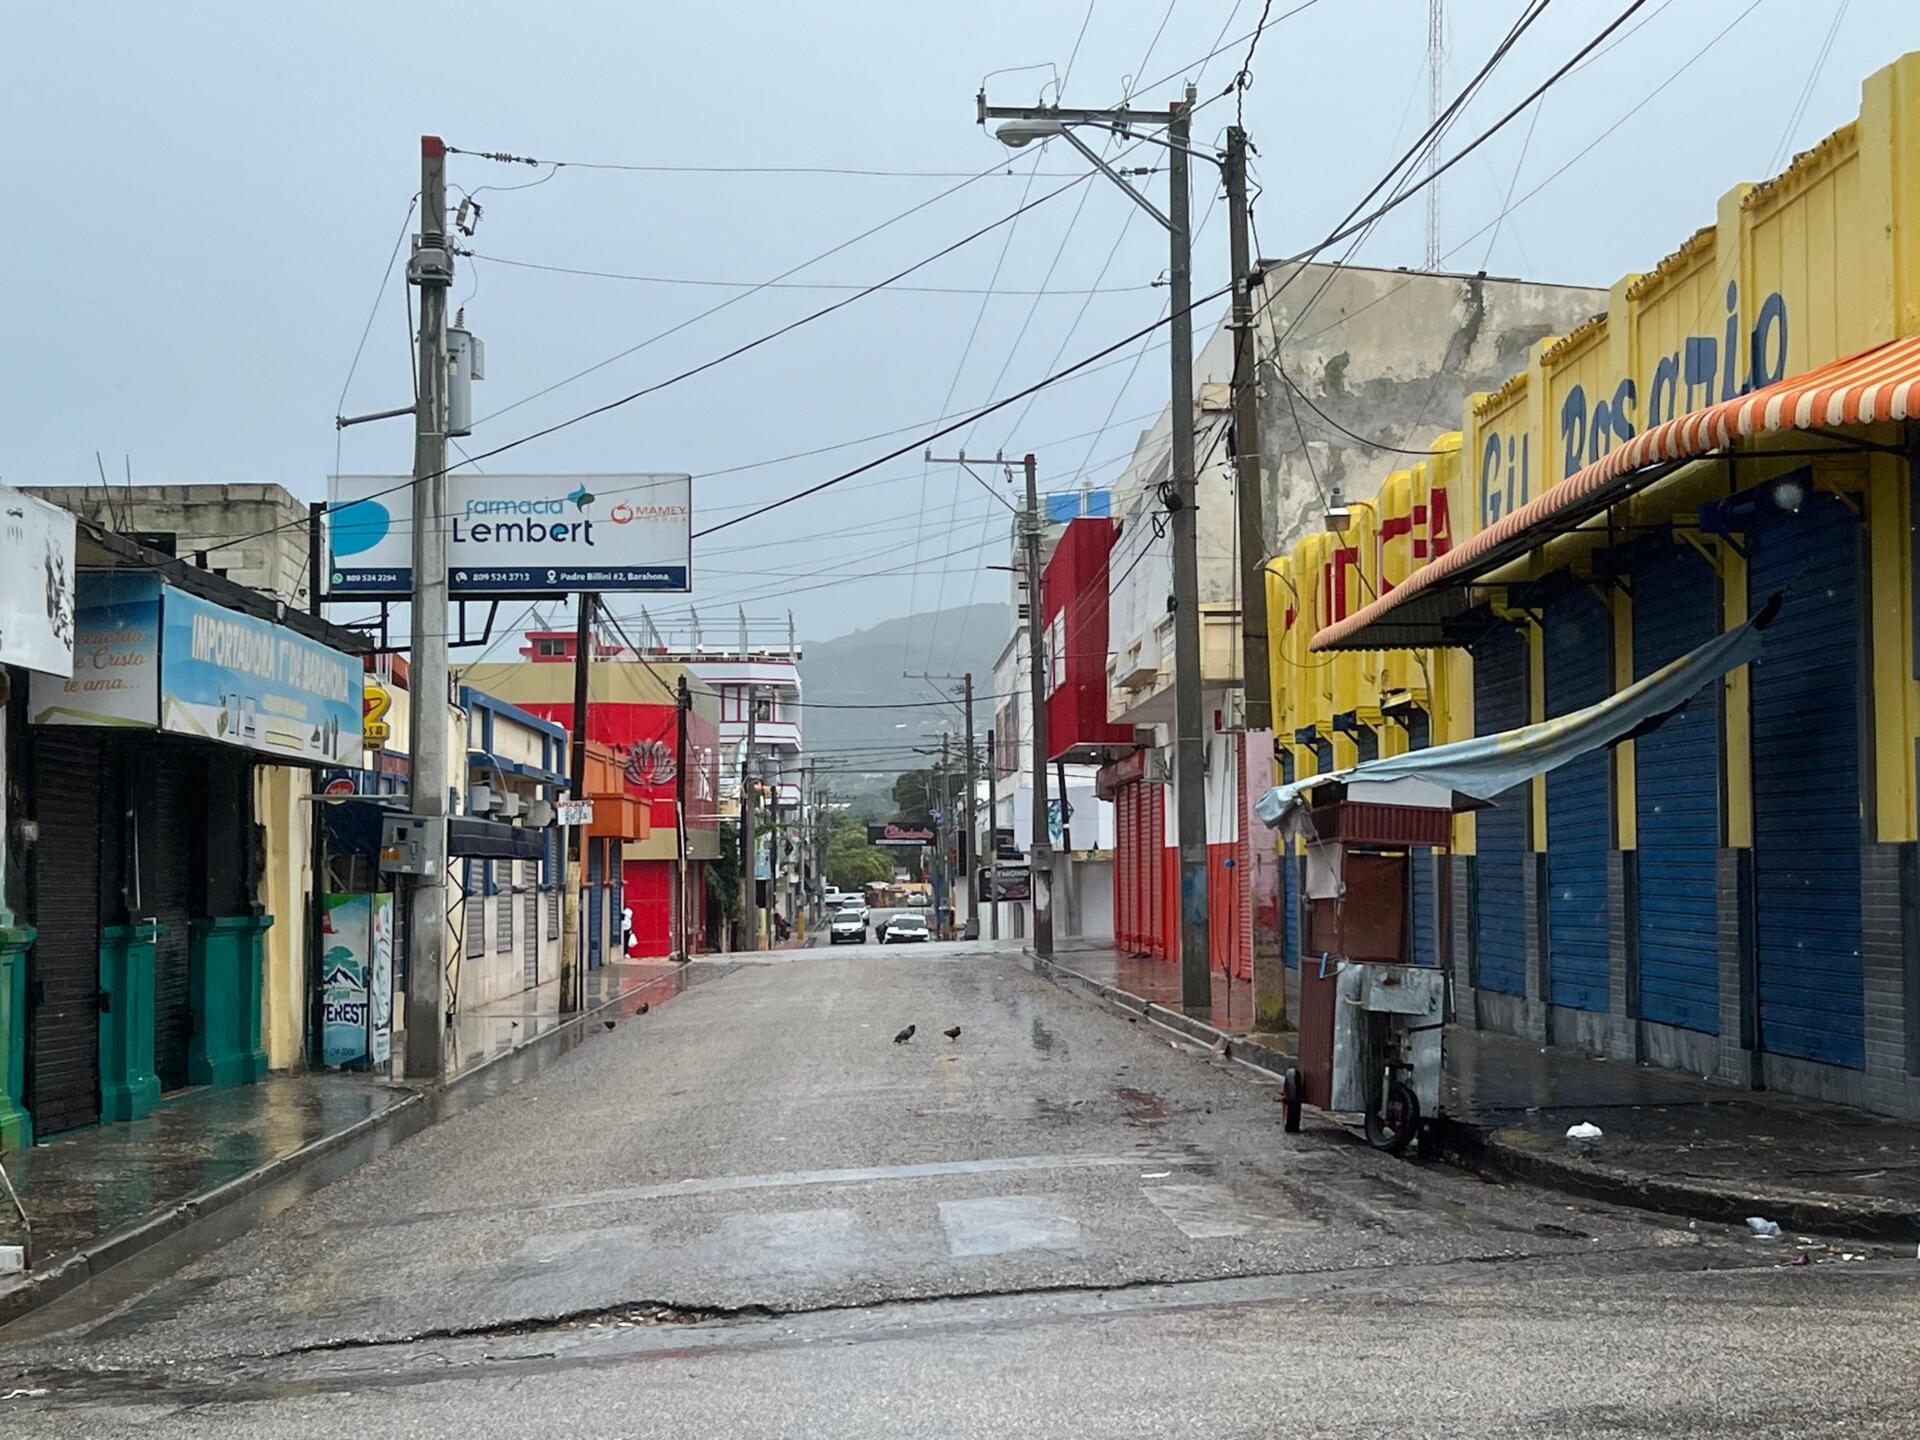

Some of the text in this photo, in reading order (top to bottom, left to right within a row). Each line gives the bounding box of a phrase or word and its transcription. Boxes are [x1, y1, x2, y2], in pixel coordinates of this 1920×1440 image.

[1481, 279, 1788, 531] Gil Rosario
[464, 496, 564, 521] farmacia
[635, 505, 687, 516] MAMEY
[453, 517, 595, 547] Lembert
[345, 574, 361, 582] 809
[362, 574, 376, 582] 524
[472, 573, 530, 582] 809 524 3713
[560, 571, 586, 581] Padre
[627, 571, 669, 581] Barahona
[191, 613, 276, 681] IMPORTADORA
[88, 646, 145, 670] Cristo
[63, 679, 80, 693] te
